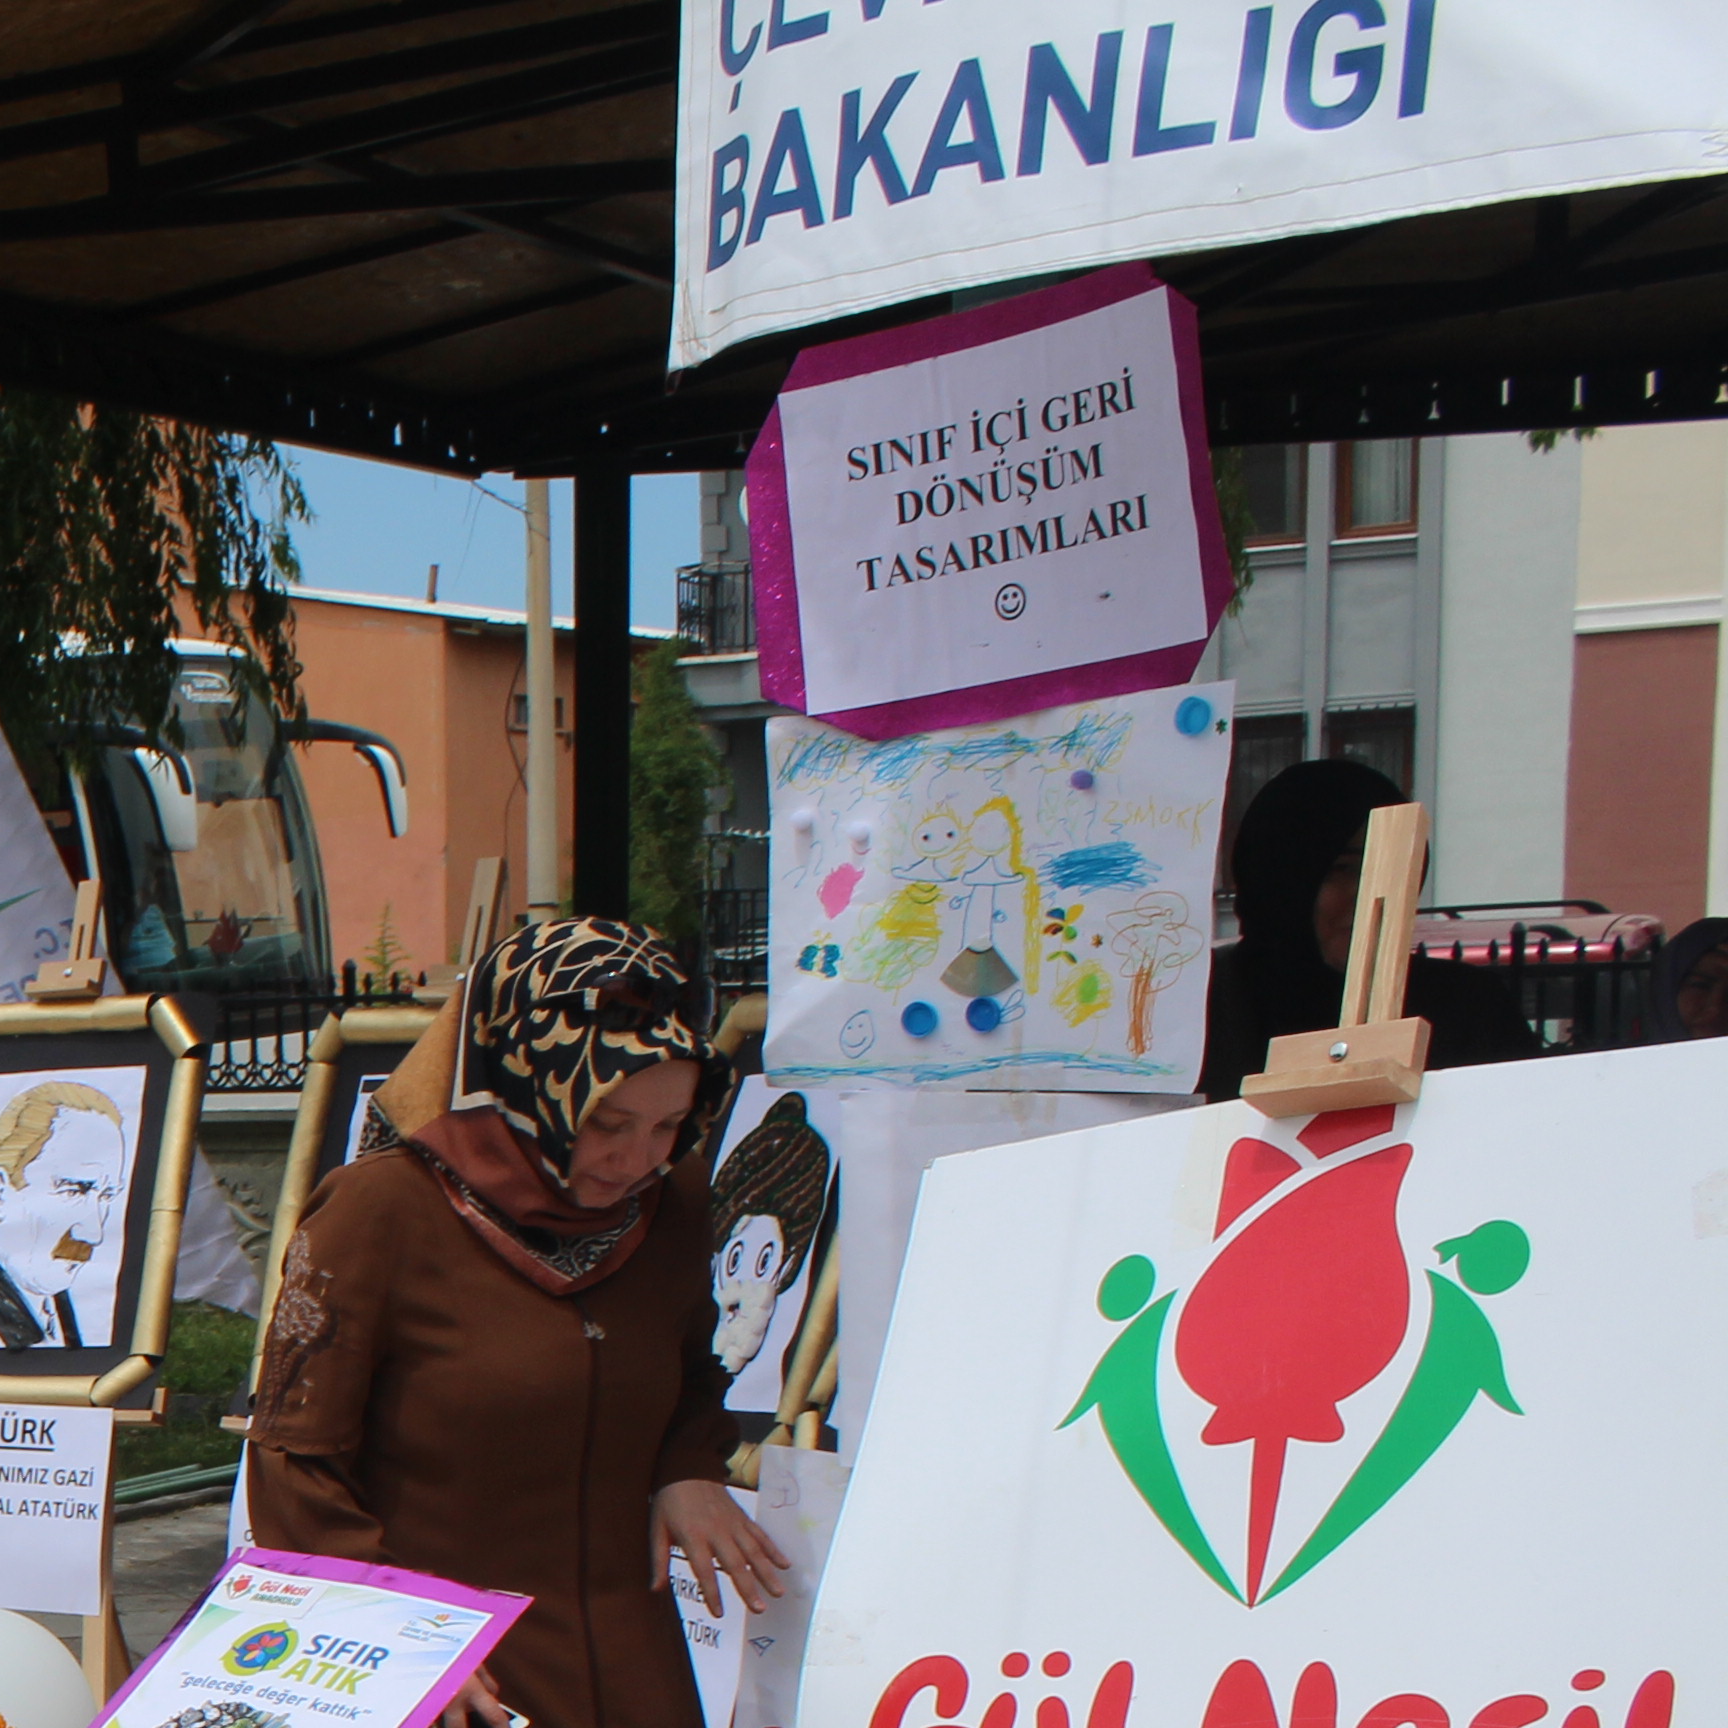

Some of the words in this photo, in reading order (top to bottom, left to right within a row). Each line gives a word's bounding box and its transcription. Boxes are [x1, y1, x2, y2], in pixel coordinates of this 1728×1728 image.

[847, 424, 957, 482] SINIF
[970, 398, 1031, 455] İÇİ
[1042, 367, 1136, 433] GERİ
[896, 442, 1105, 526] DÖNÜŞÜM
[856, 493, 1150, 592] TASARIMLARI
[53, 1467, 95, 1487] GAZİ
[17, 1498, 99, 1520] ATATÜRK
[302, 1634, 389, 1670] SIFIR
[280, 1658, 373, 1695] ATIK
[256, 1685, 308, 1706] değer
